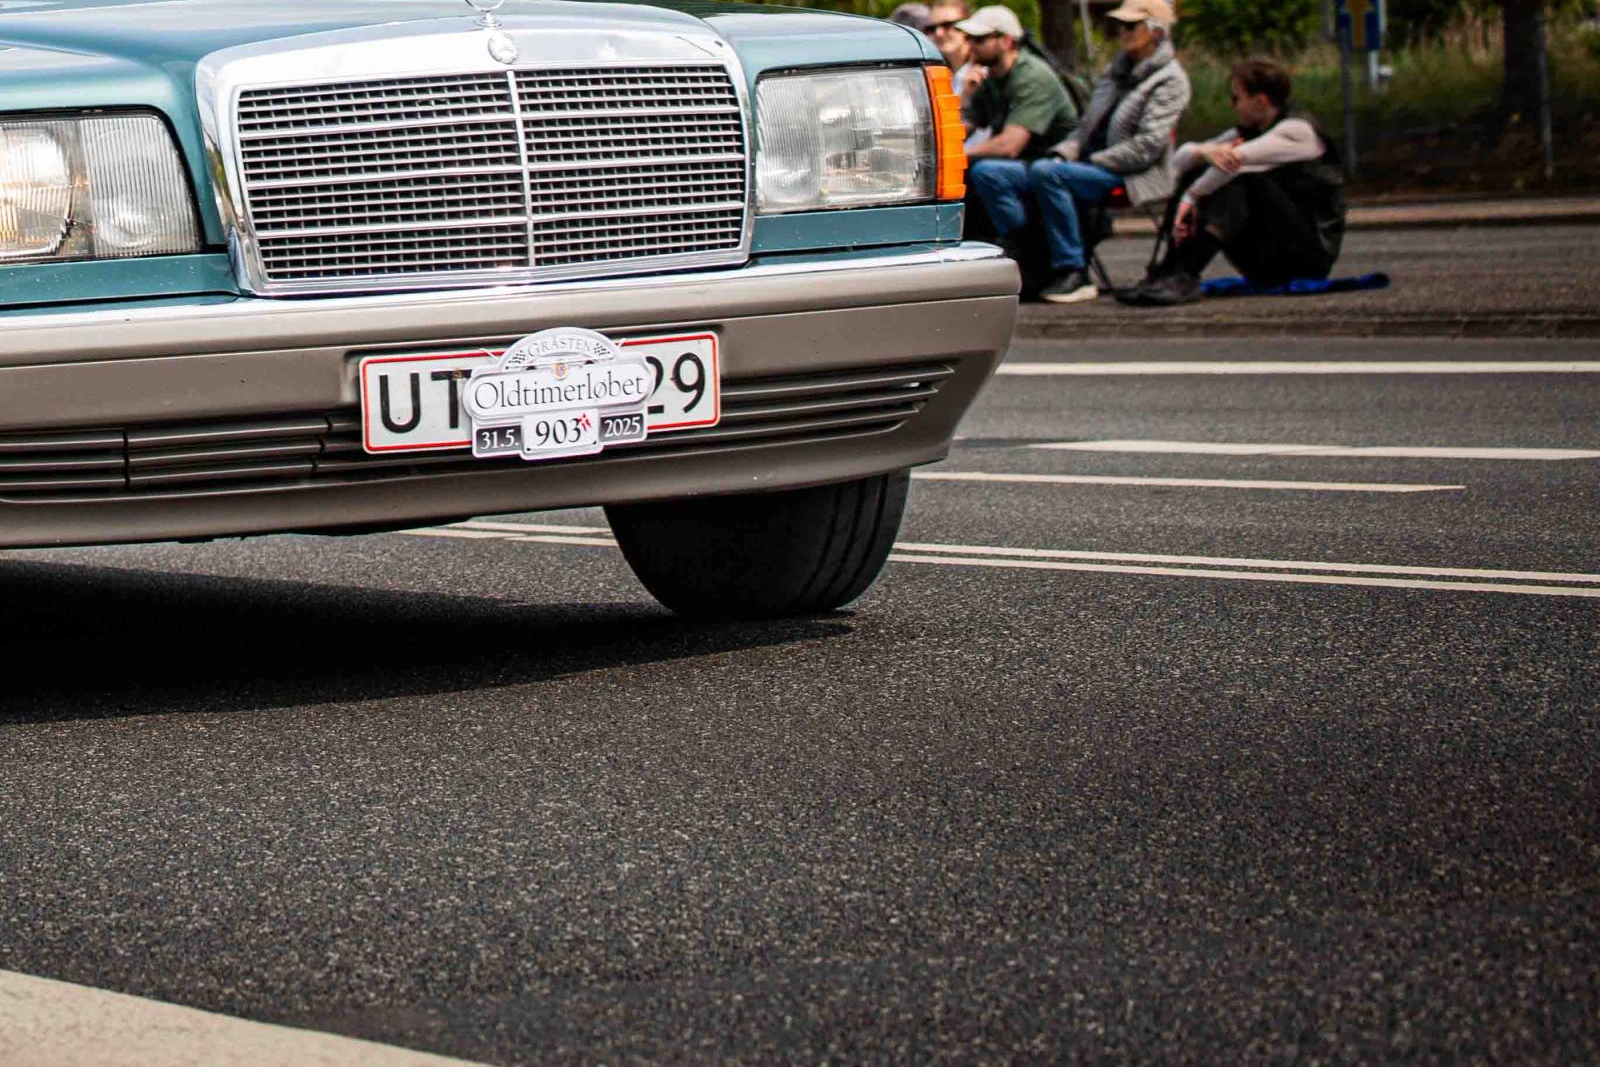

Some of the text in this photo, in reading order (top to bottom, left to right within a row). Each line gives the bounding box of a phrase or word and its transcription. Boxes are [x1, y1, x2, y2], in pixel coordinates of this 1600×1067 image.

[378, 369, 472, 434] UT
[480, 416, 641, 450] 31.5. 903 2025
